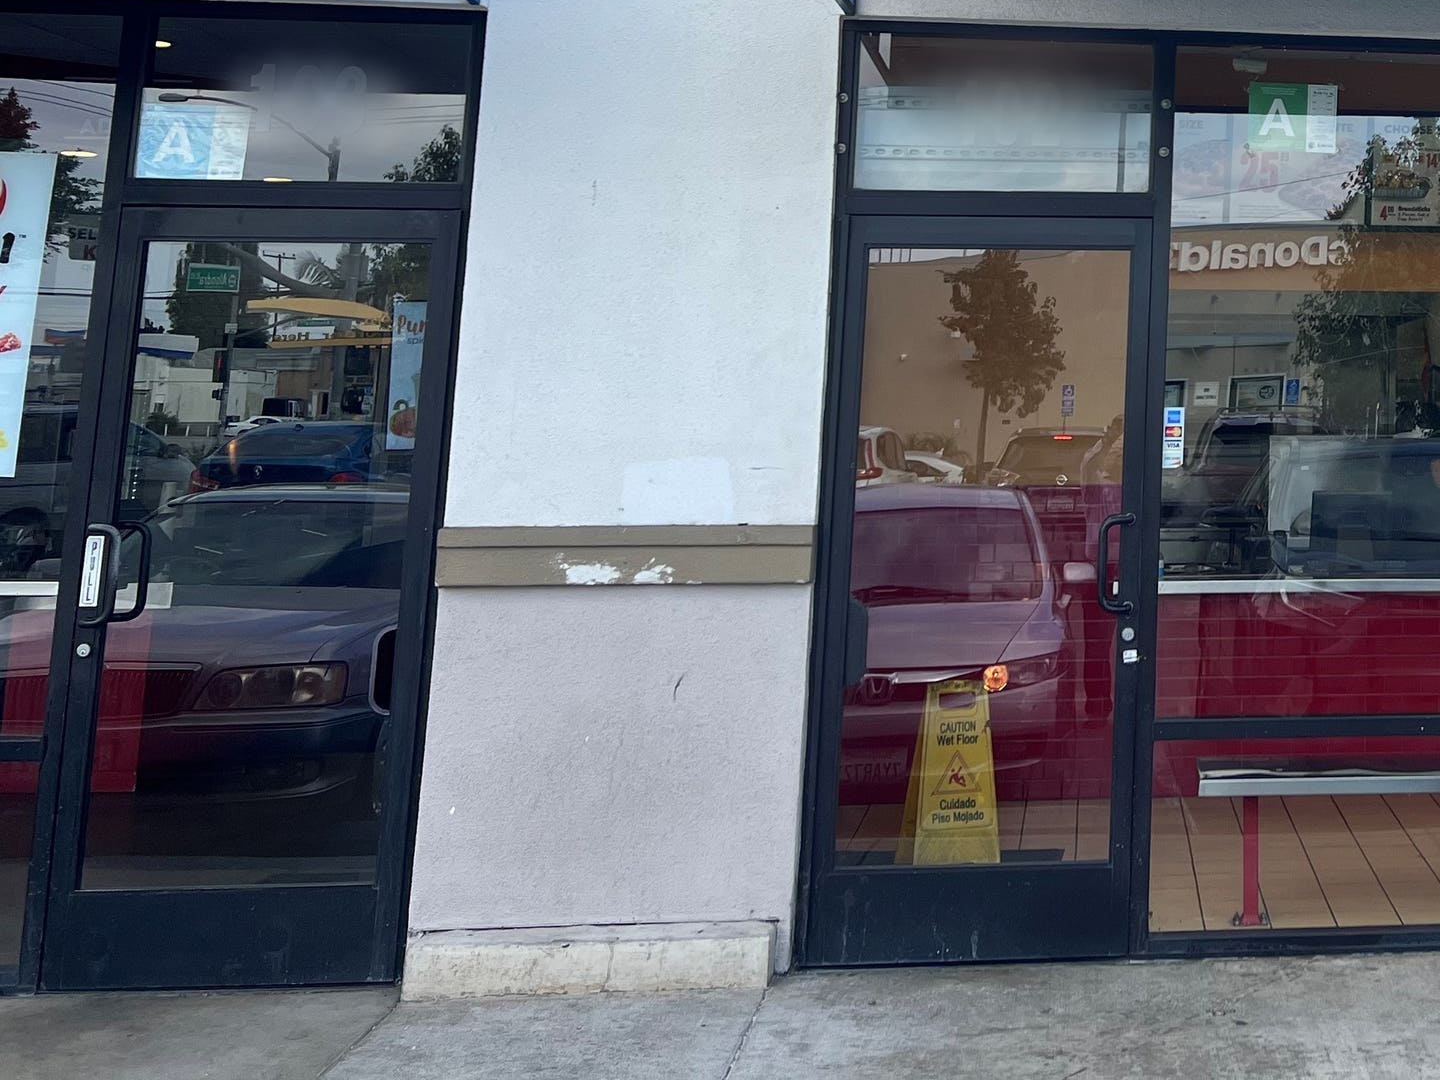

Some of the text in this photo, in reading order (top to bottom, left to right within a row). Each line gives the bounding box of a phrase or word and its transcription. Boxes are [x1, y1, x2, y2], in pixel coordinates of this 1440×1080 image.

[1258, 97, 1296, 137] A
[152, 120, 195, 164] A
[1379, 205, 1388, 221] 4
[86, 541, 98, 601] PULL
[940, 721, 977, 735] CAUTION
[937, 733, 979, 747] Wet Floor
[939, 797, 976, 811] Cuidado
[932, 810, 985, 824] Piso Mojado
